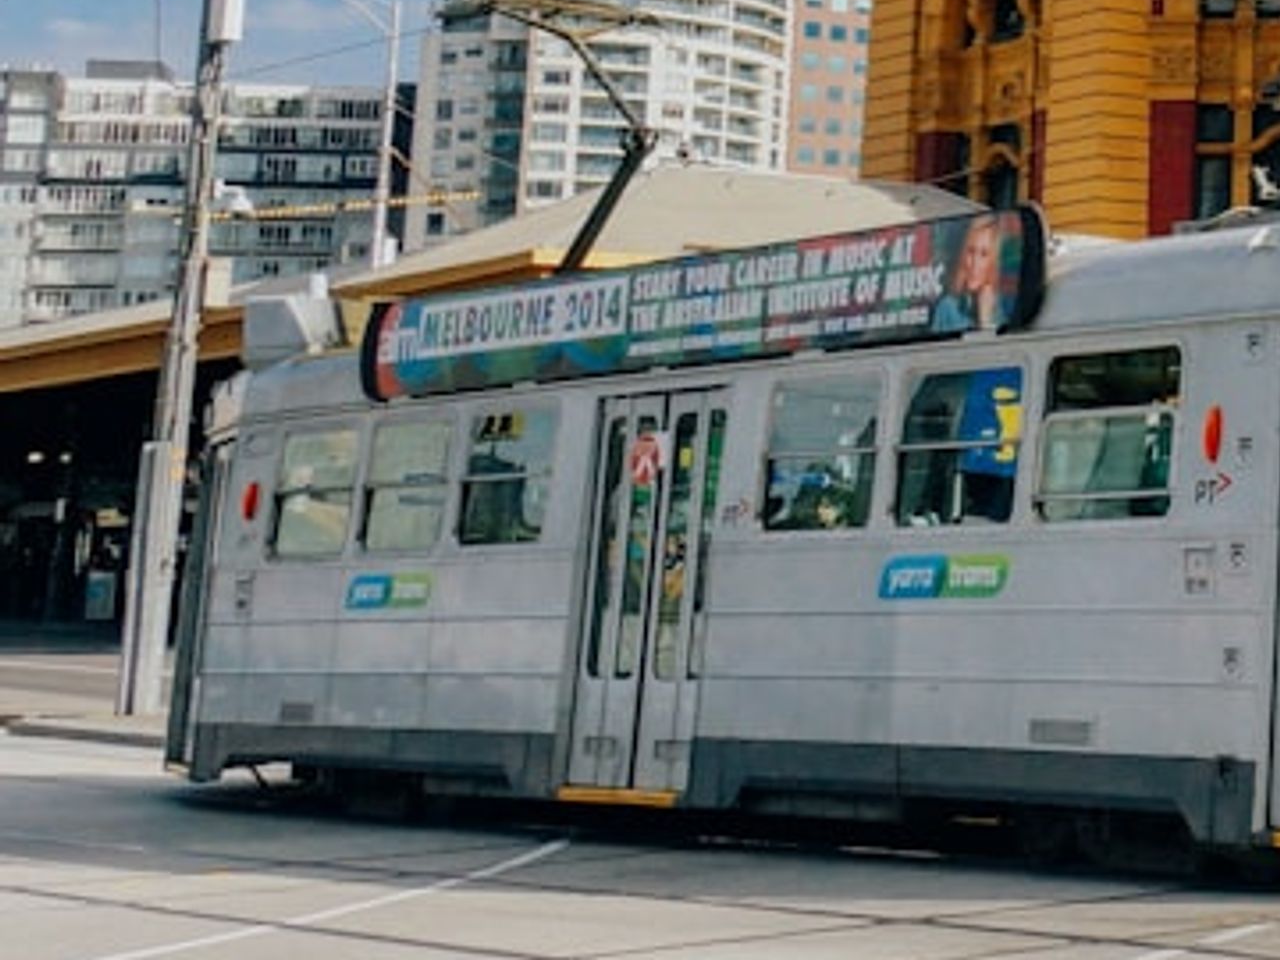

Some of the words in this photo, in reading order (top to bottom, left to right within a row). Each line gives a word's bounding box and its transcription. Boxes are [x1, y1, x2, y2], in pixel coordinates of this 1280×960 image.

[629, 301, 661, 334] THE
[661, 287, 764, 329] AUSTRALIAN
[766, 276, 853, 317] INSTITUTE
[853, 271, 882, 306] OF
[882, 260, 946, 301] MUSIC
[632, 267, 682, 302] START
[684, 261, 731, 294] YOUR
[735, 249, 799, 287] CAREER
[801, 246, 828, 280] IN
[828, 236, 887, 277] MUSIC
[888, 232, 917, 266] AT
[422, 296, 555, 346] MELBOURNE
[563, 284, 623, 332] 2014
